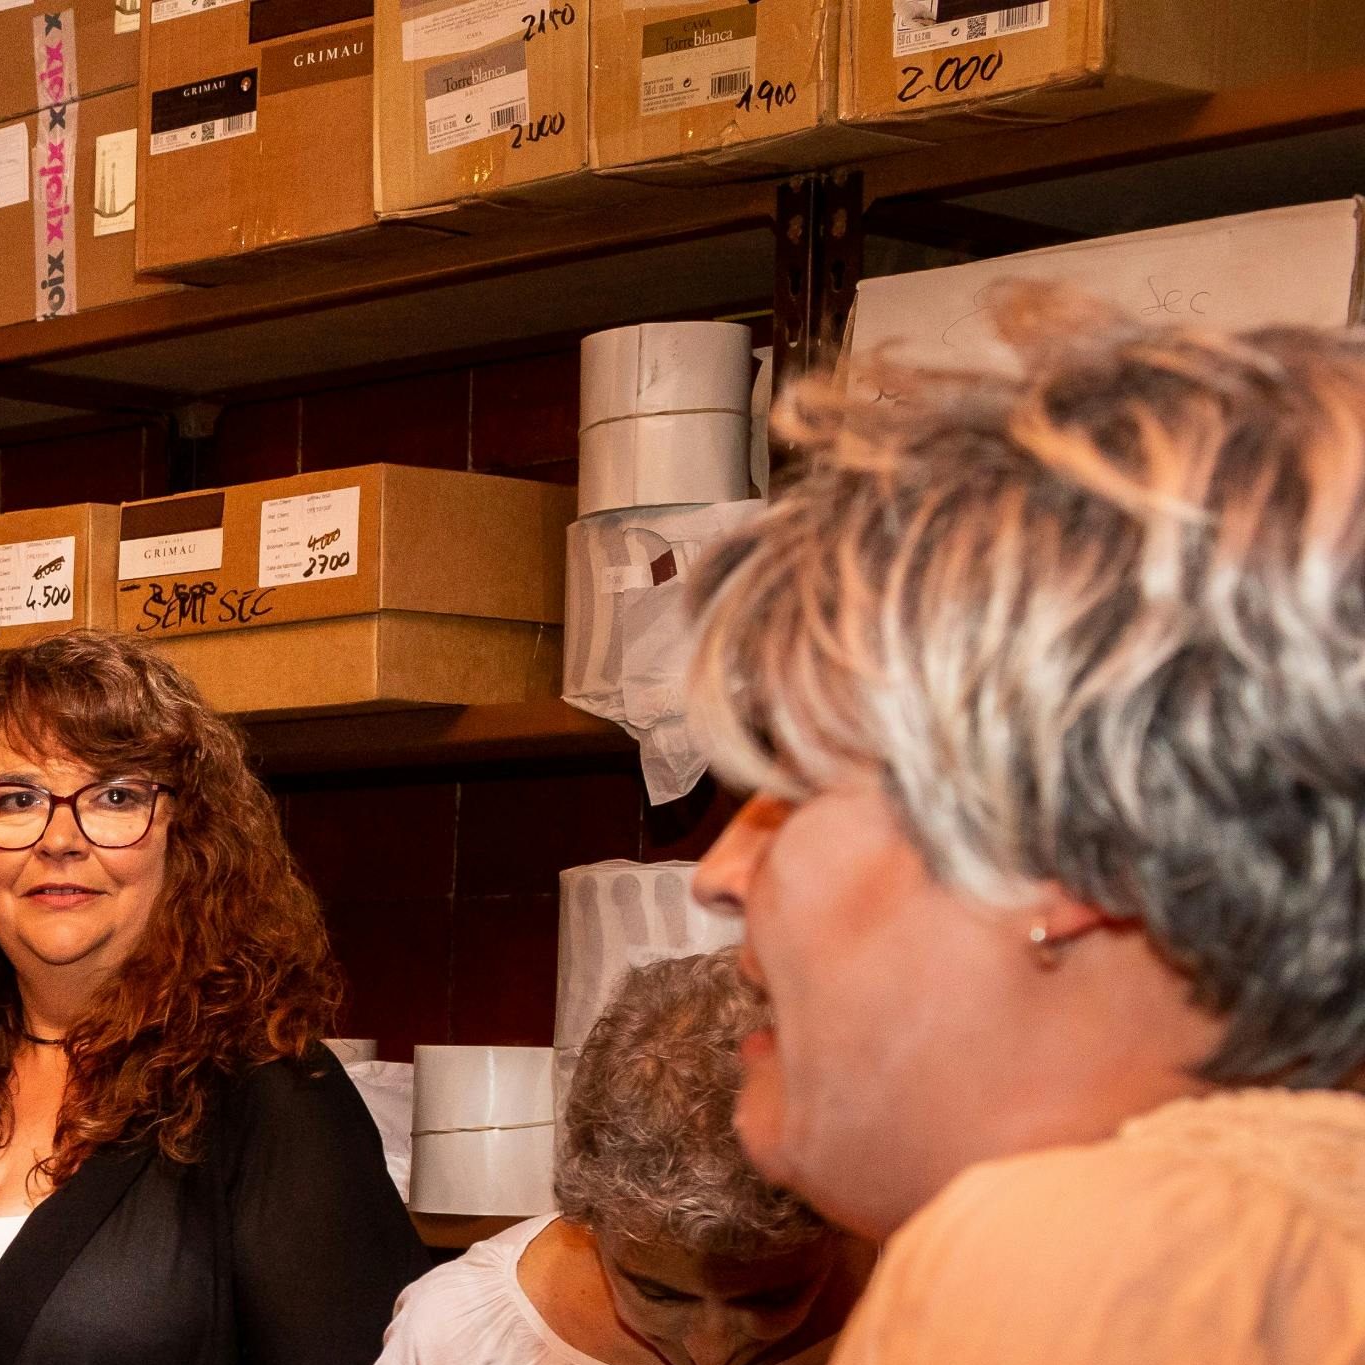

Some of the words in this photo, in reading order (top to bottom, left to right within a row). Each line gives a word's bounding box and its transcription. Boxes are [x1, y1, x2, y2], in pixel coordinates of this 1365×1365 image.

[663, 29, 734, 52] Torreblanca
[293, 41, 364, 68] GRIMAU
[183, 79, 227, 98] GRIMAU
[443, 64, 508, 93] Torreblanca
[143, 543, 197, 560] GRIMAU
[302, 551, 350, 579] 2700
[25, 584, 71, 611] 4.500
[219, 588, 277, 623] SEC
